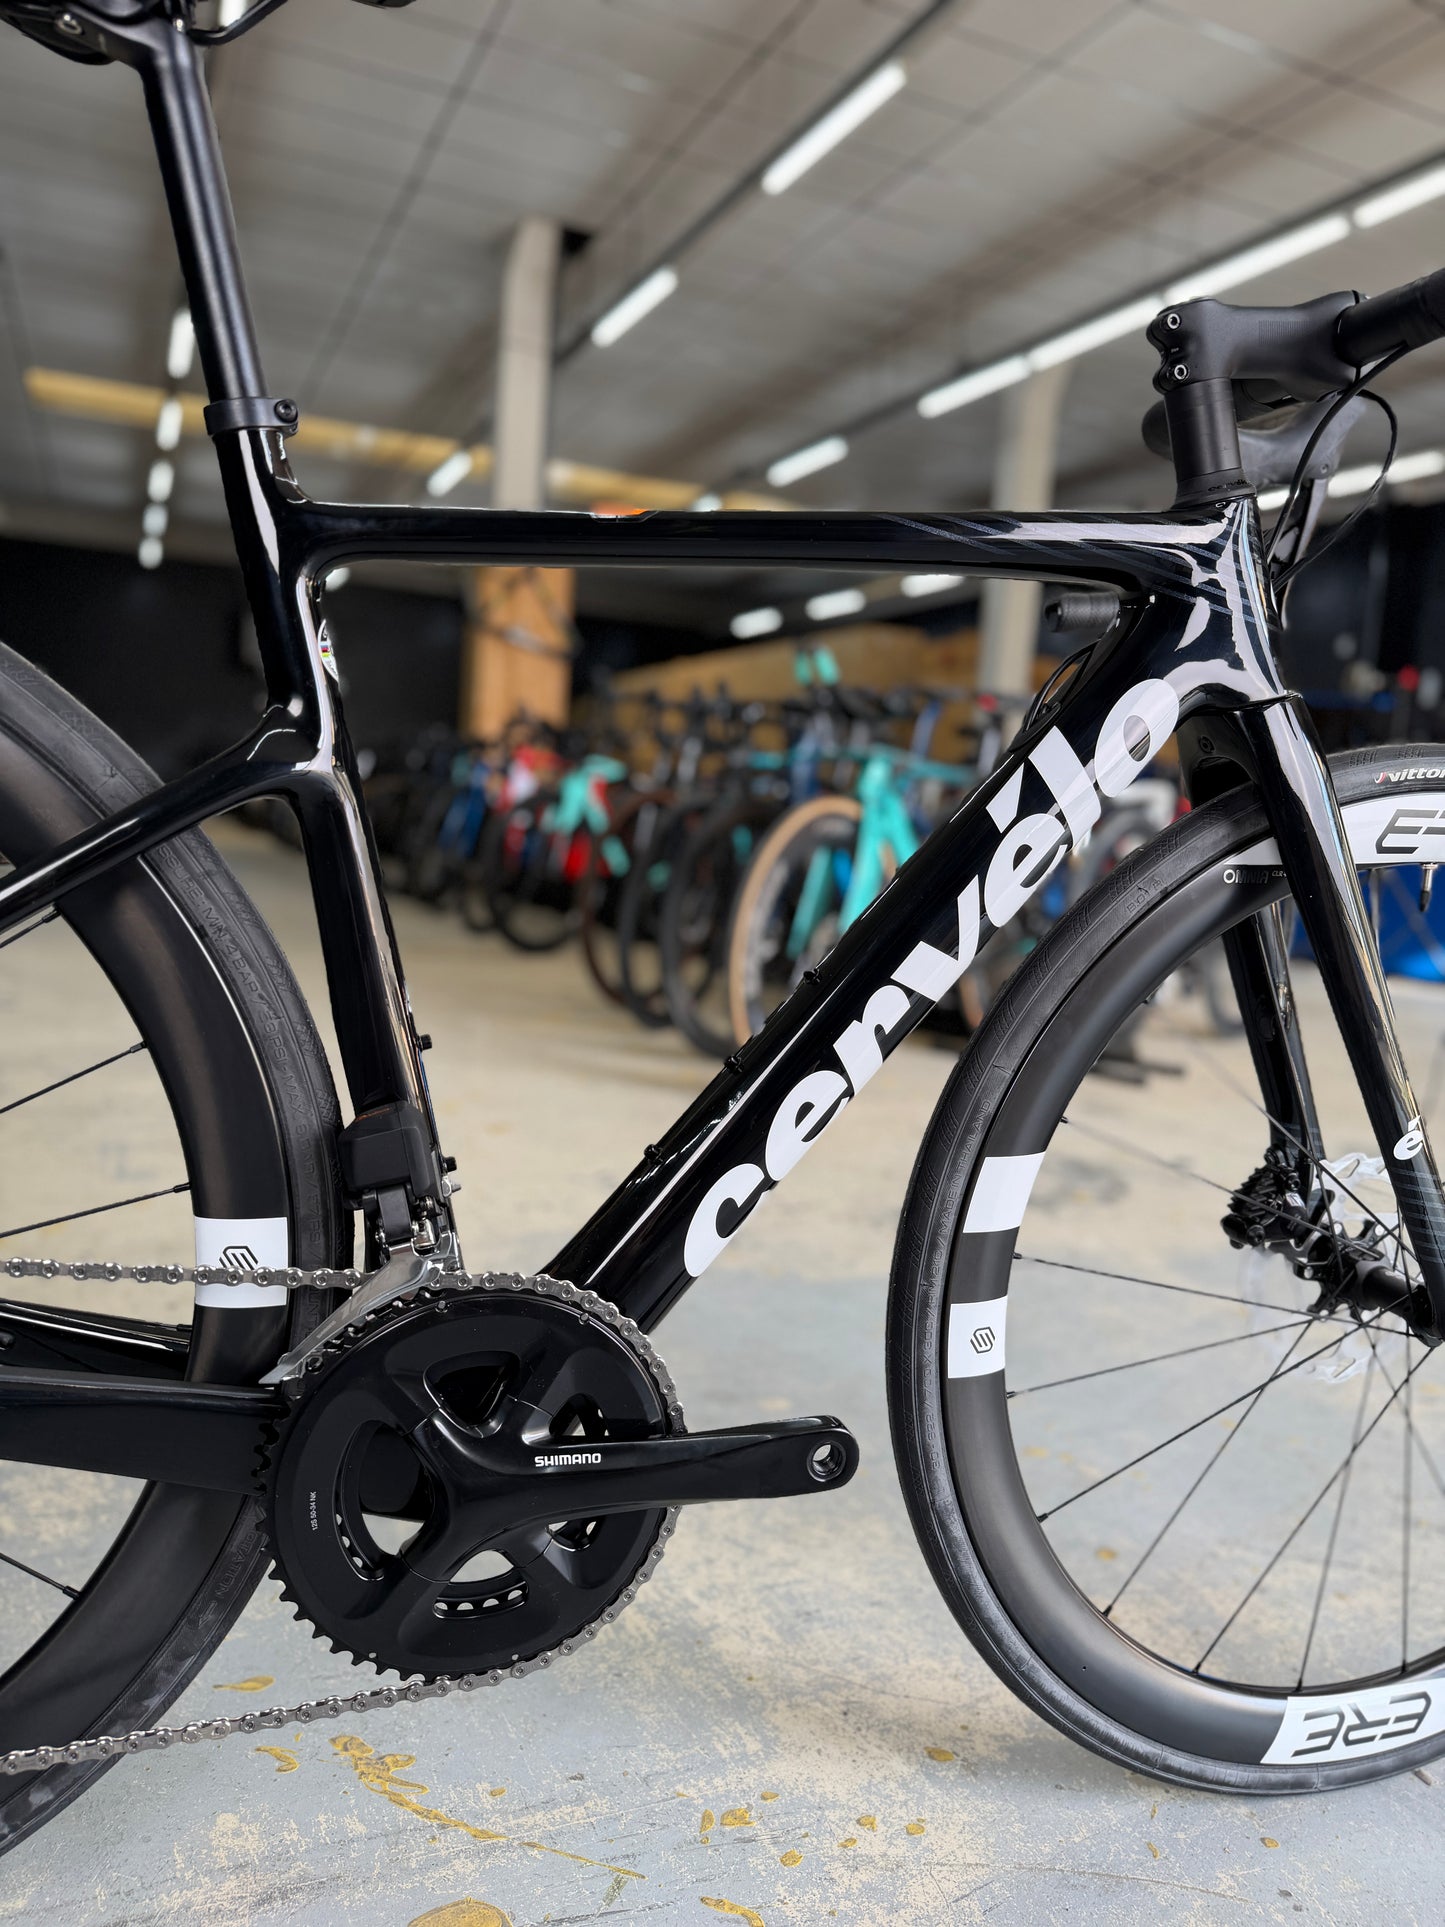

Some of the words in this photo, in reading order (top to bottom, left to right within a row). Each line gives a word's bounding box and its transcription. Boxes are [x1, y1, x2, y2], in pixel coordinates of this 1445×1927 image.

[684, 678, 1180, 1278] cervélo
[534, 1453, 602, 1468] SHIMANO
[215, 1531, 257, 1598] OTATION
[1291, 1691, 1432, 1758] ERE
